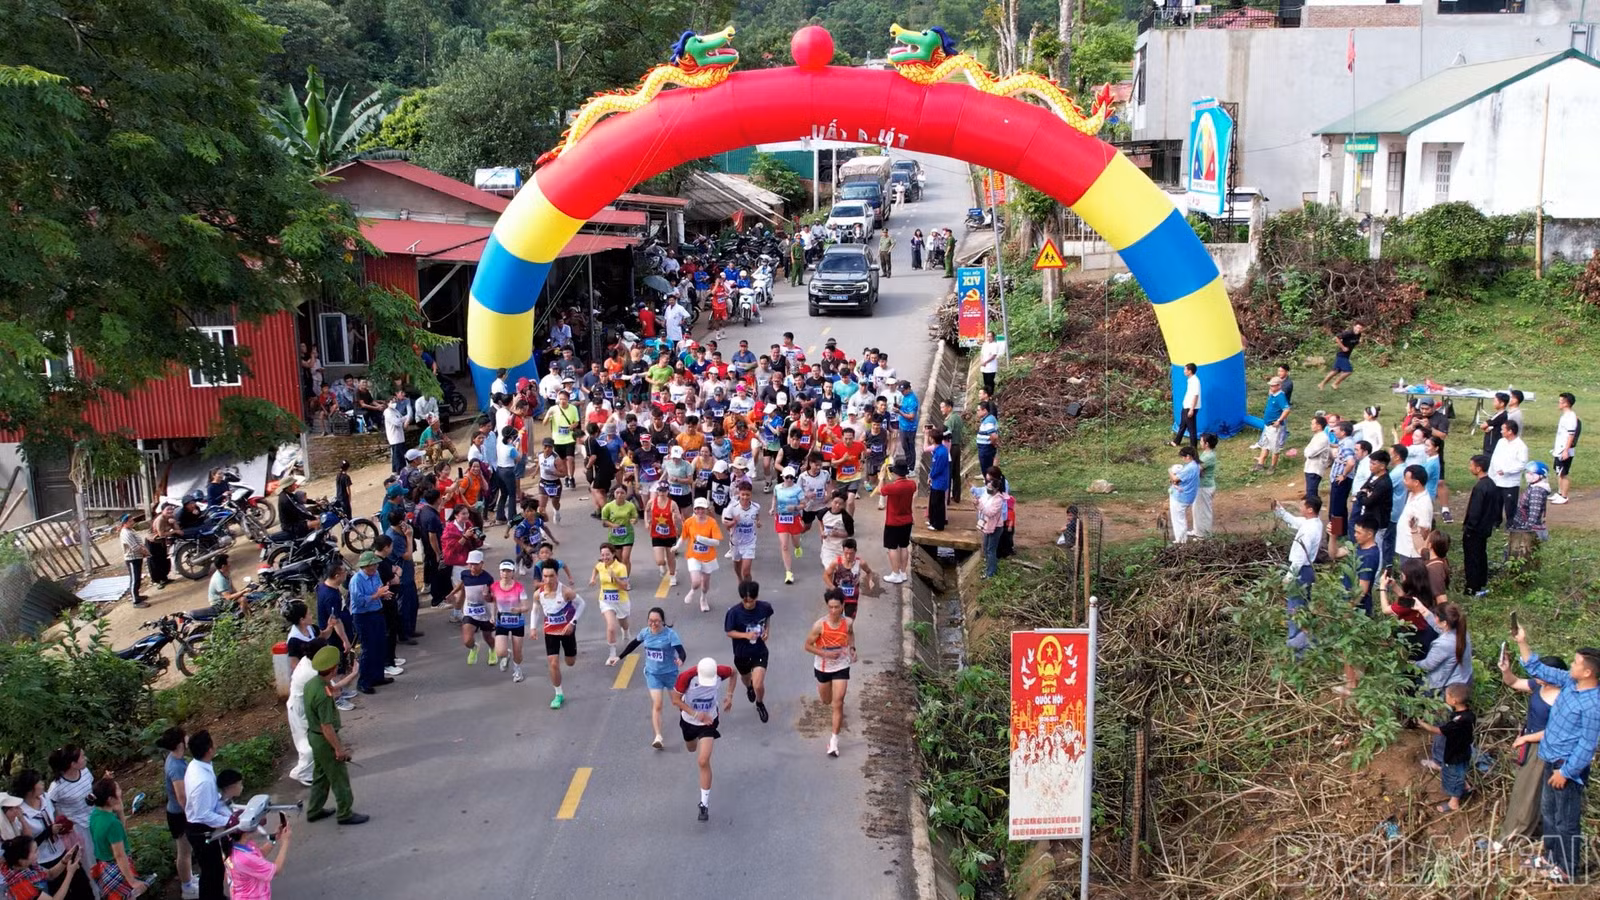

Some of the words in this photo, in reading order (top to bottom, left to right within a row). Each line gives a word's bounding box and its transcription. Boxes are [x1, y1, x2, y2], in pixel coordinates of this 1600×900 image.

[962, 276, 981, 286] XIV
[647, 650, 663, 660] A-075
[1034, 694, 1051, 705] QUỐC
[1052, 694, 1064, 706] HỘI
